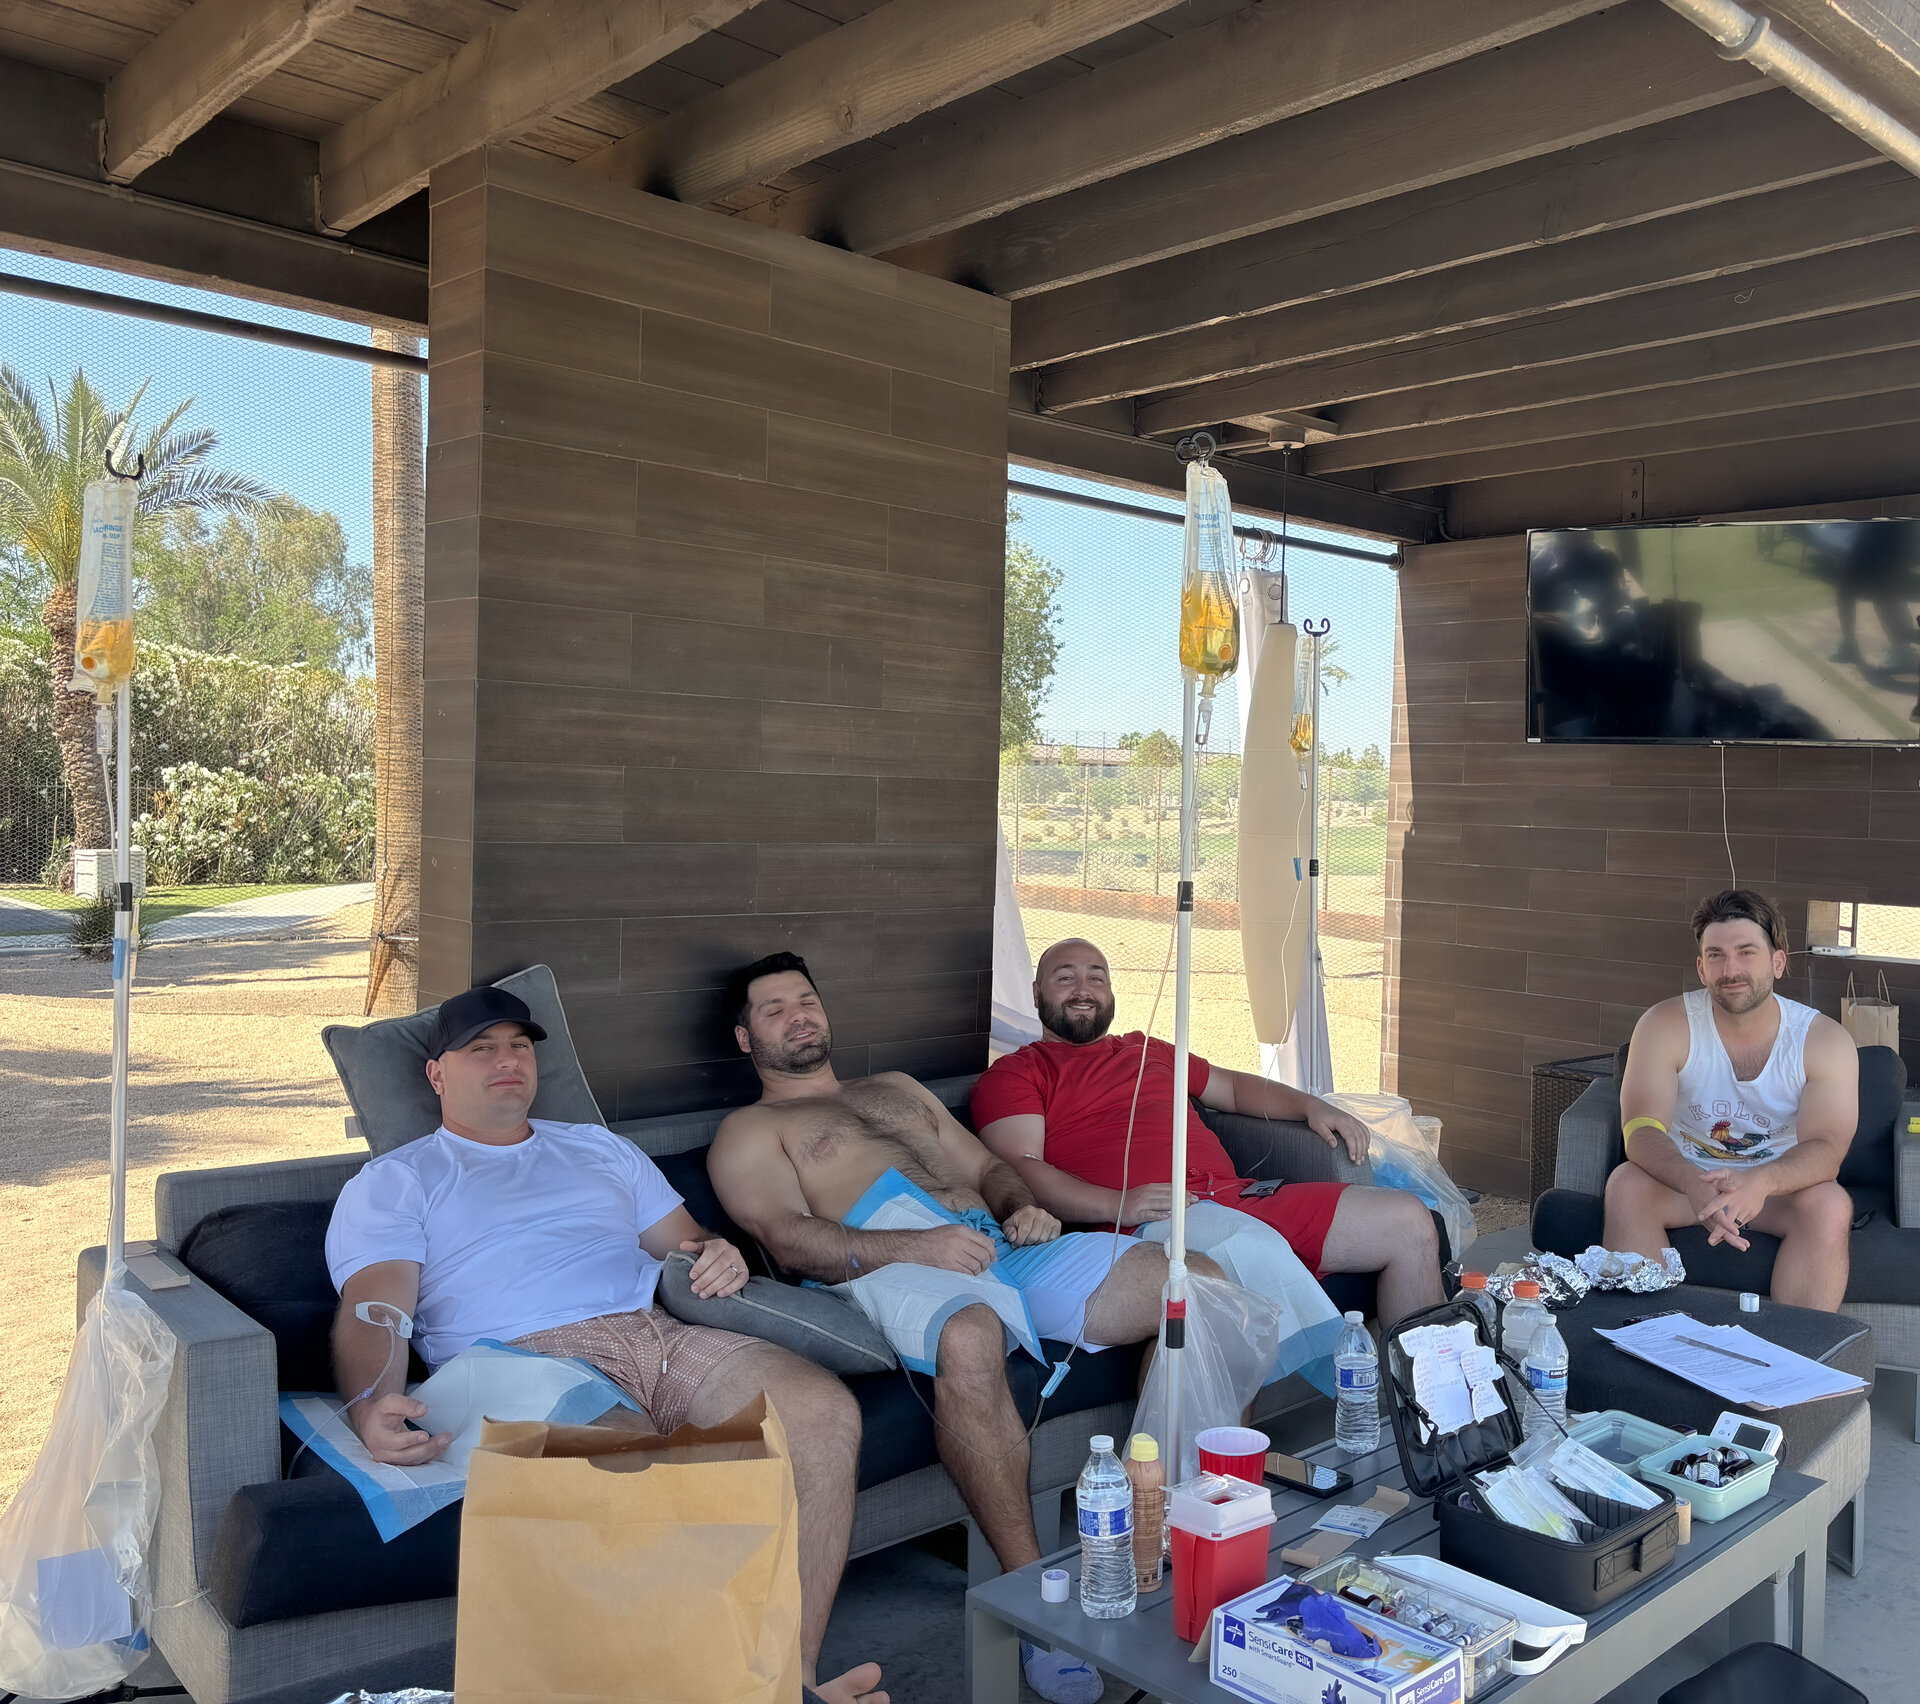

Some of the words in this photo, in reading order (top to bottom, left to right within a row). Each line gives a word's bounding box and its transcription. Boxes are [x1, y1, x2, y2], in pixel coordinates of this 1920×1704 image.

[1248, 1630, 1294, 1659] SensiCare
[1296, 1652, 1312, 1669] Silk
[1248, 1644, 1261, 1655] with
[1222, 1664, 1238, 1678] 250
[1416, 1676, 1444, 1699] SensiCare
